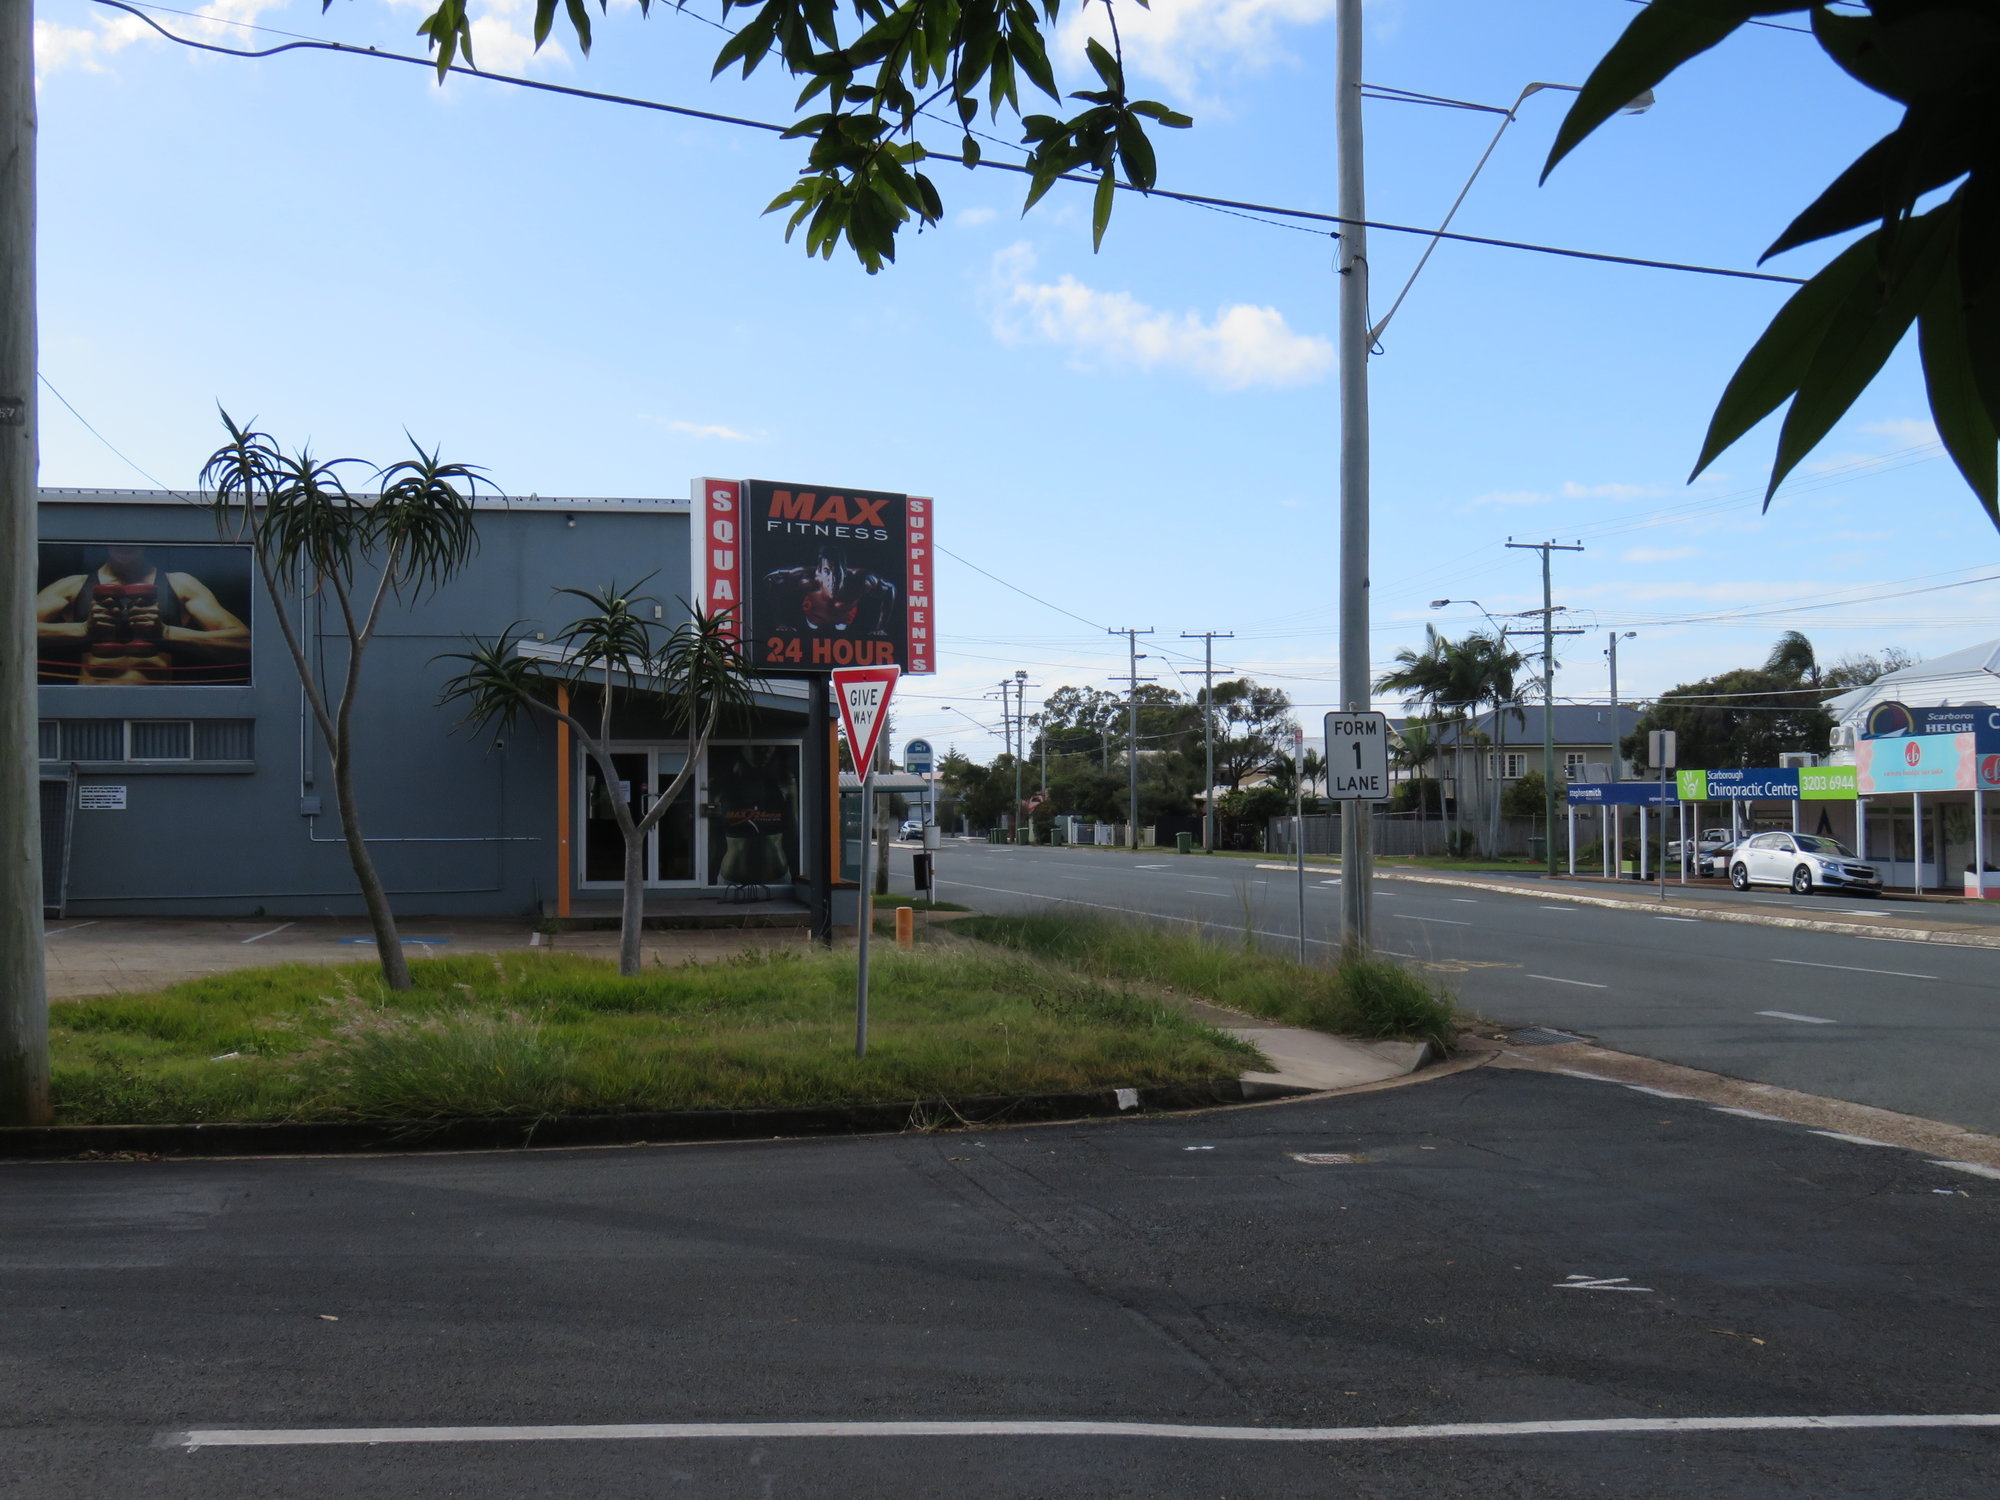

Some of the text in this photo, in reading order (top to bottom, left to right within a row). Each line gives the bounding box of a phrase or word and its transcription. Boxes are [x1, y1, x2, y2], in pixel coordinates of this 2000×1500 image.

[768, 489, 889, 527] MAX
[767, 520, 888, 541] FITNESS
[908, 500, 928, 671] SUPPLEMENTS
[767, 637, 895, 665] 24 HOUR
[850, 689, 878, 706] GIVE
[853, 711, 873, 725] WAY
[1334, 721, 1377, 735] FORM
[1352, 742, 1362, 769] 1
[1337, 776, 1379, 790] LANE
[1707, 770, 1743, 781] Scarborough
[1803, 776, 1854, 790] 3203 6944
[1707, 781, 1798, 798] Chiropractic Centre
